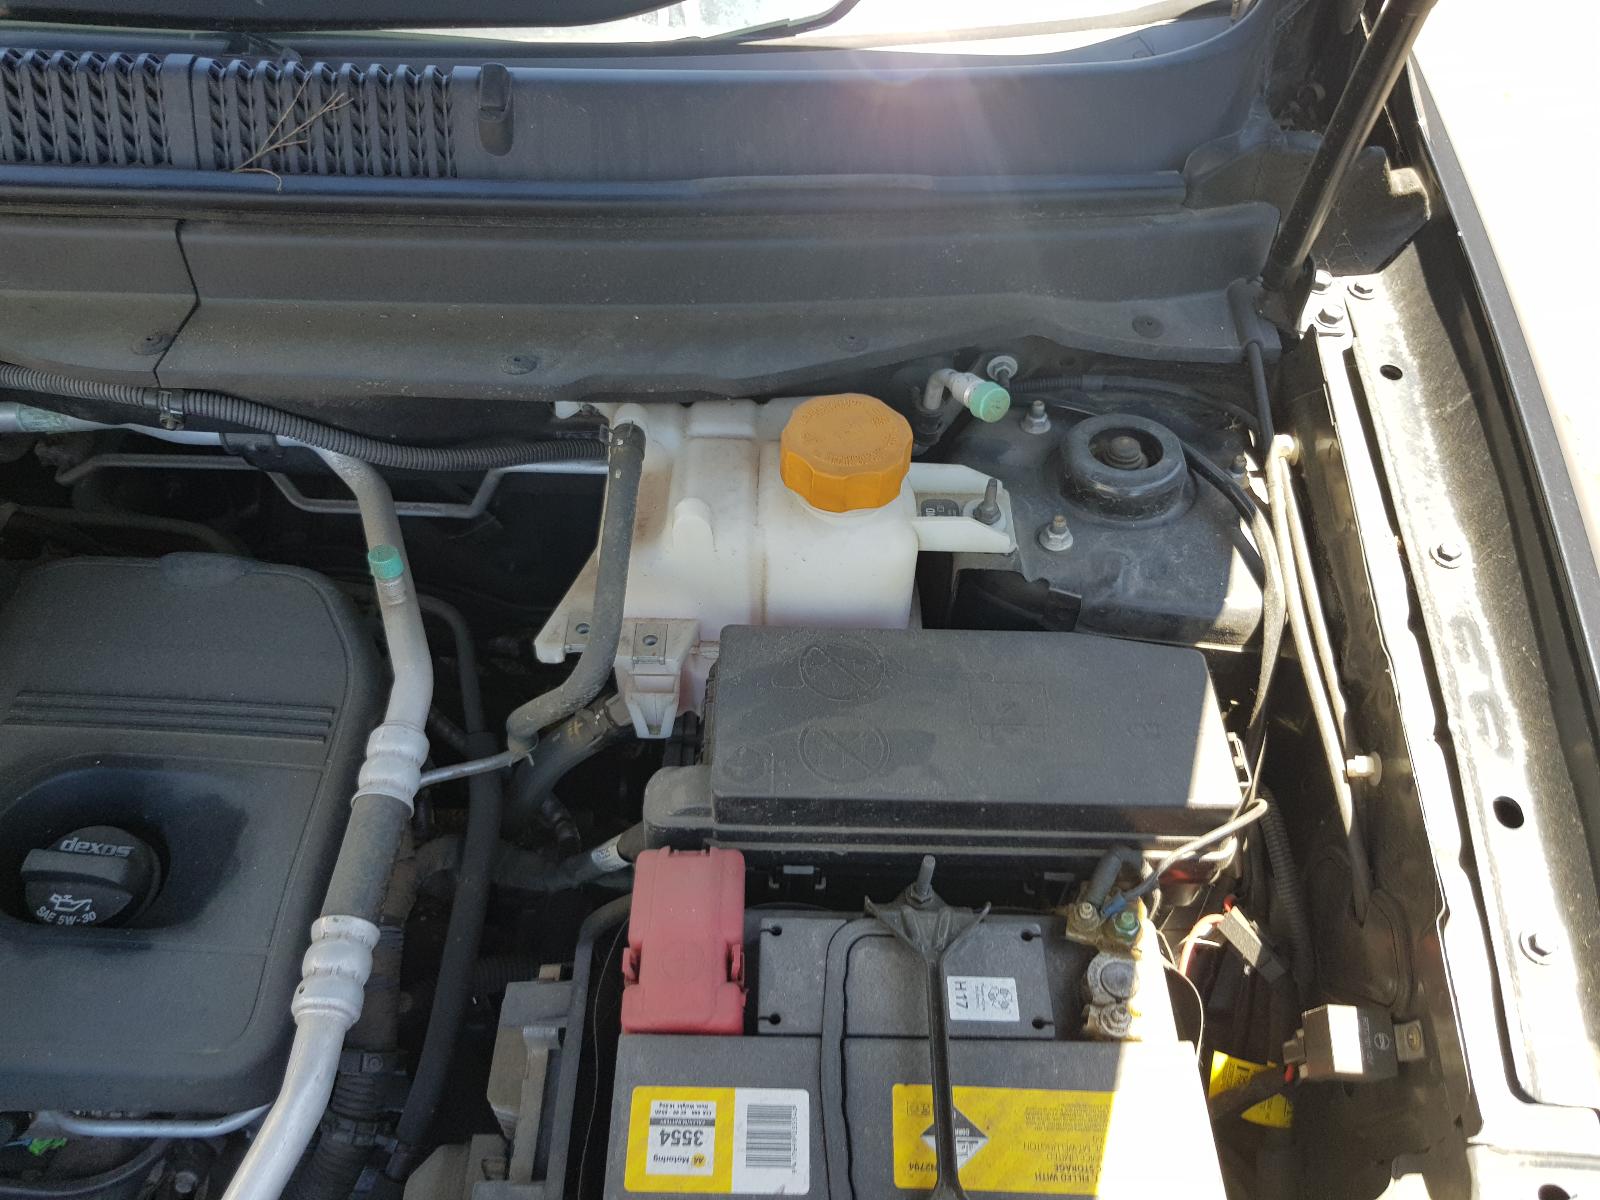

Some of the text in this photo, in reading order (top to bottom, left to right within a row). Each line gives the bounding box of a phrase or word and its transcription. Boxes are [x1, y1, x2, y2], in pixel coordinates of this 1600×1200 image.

[60, 836, 134, 857] dexos
[36, 905, 97, 926] SAE 5W-30
[659, 1129, 704, 1147] 3554
[653, 1154, 705, 1165] AA Motoring
[1055, 1163, 1094, 1172] STORAGE
[1035, 1172, 1089, 1182] FILLED WITH
